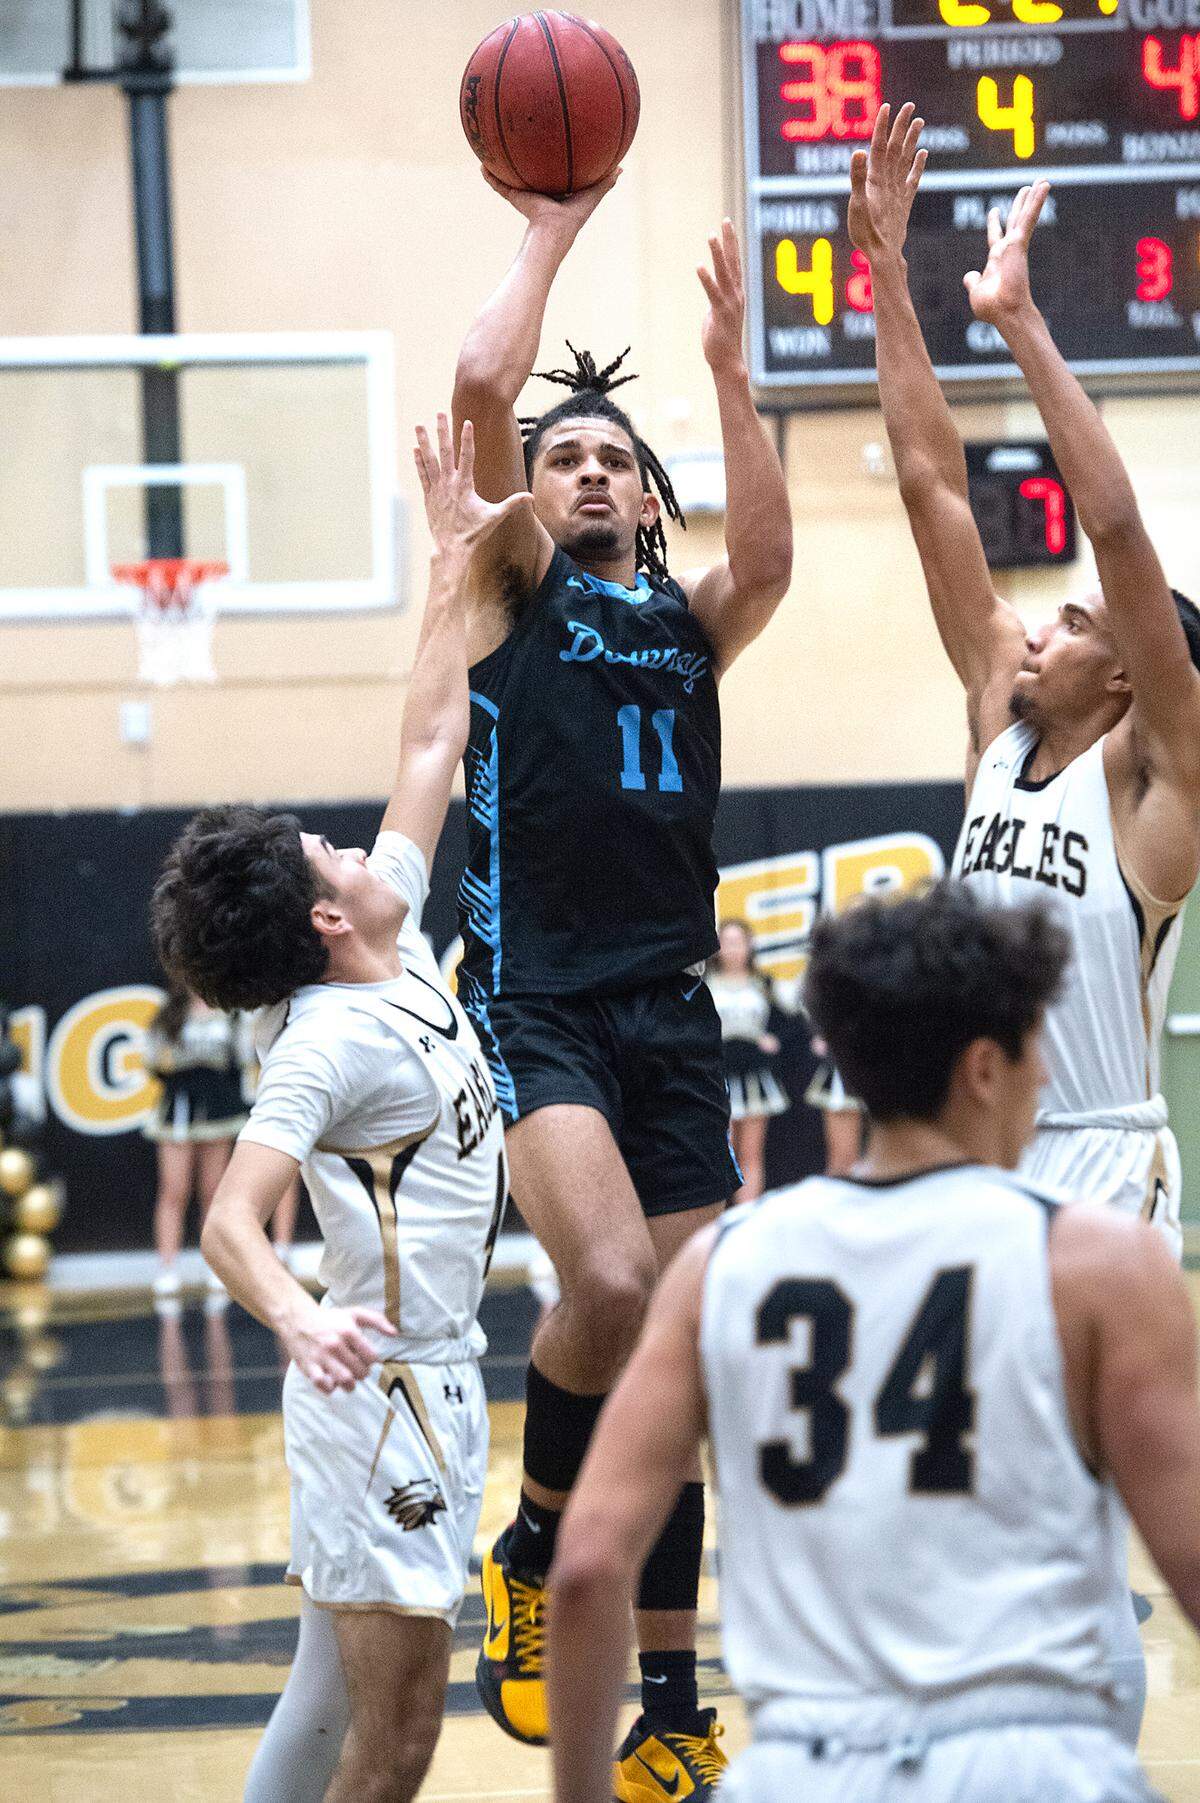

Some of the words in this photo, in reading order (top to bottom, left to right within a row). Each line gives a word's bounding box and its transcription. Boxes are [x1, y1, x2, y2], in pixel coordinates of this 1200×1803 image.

[779, 40, 883, 142] 38
[977, 74, 1035, 159] 4
[1142, 33, 1200, 121] 4
[776, 238, 834, 326] 4
[1136, 236, 1174, 302] 3
[1019, 477, 1067, 555] 7
[616, 704, 684, 793] 11
[959, 812, 1090, 898] EAGLES
[754, 1264, 974, 1512] 34
